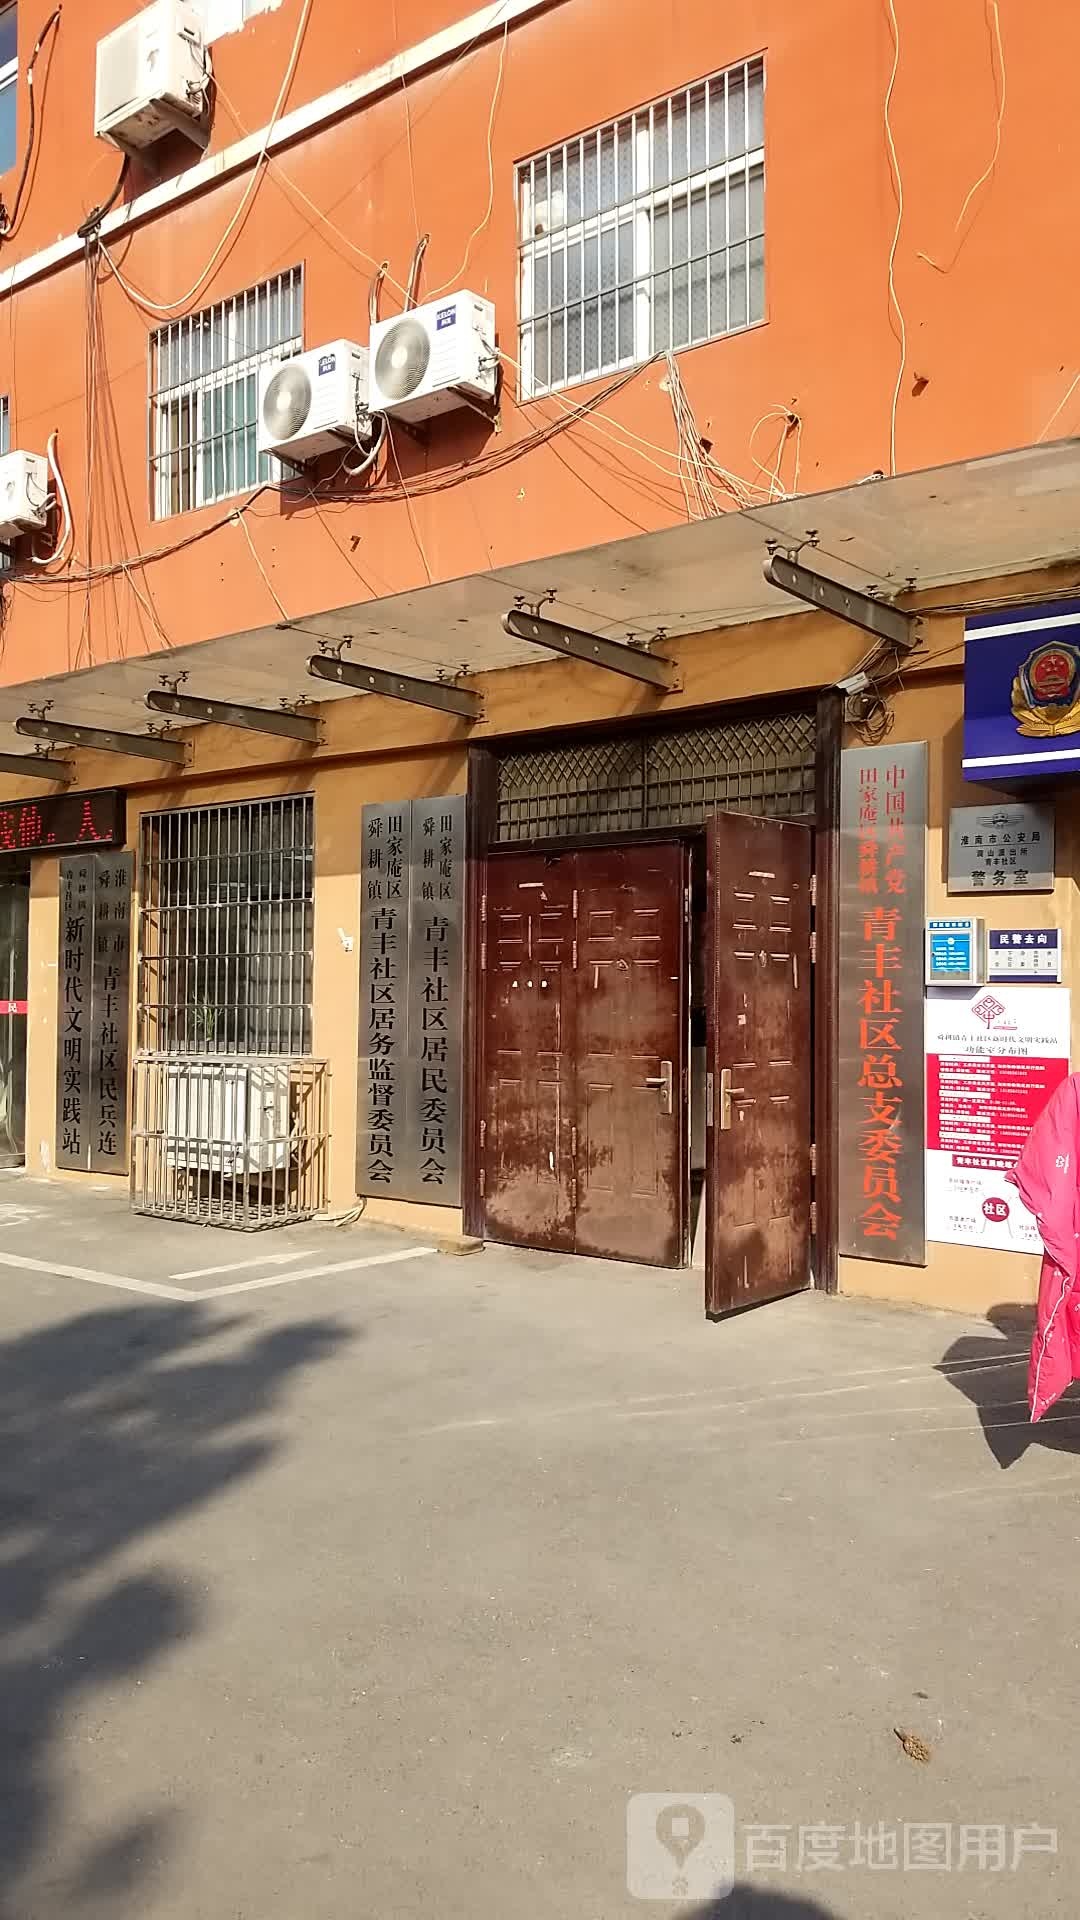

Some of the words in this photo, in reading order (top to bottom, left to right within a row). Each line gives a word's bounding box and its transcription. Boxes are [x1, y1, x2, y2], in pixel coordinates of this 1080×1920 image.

[367, 816, 383, 901] 舜耕镇
[386, 815, 403, 900] 田家庵区
[422, 816, 435, 901] 舜耕镇
[439, 815, 453, 901] 田家庵区
[886, 764, 906, 895] 中国共产党
[960, 831, 1041, 846] 淮南市公安局
[985, 856, 1017, 866] 青丰社区
[98, 869, 111, 953] 舜耕镇
[113, 868, 127, 953] 淮南市
[971, 868, 1029, 887] 警务室
[999, 933, 1048, 945] 民警去向
[62, 915, 85, 1156] 新时代文明实践站
[97, 965, 121, 1156] 青丰社区民兵连
[367, 906, 397, 1184] 青丰社区居务监督委员会
[420, 916, 449, 1185] 青丰社区居民委员会
[857, 906, 902, 1242] 青丰社区总支委员会
[983, 1202, 1008, 1216] 社区
